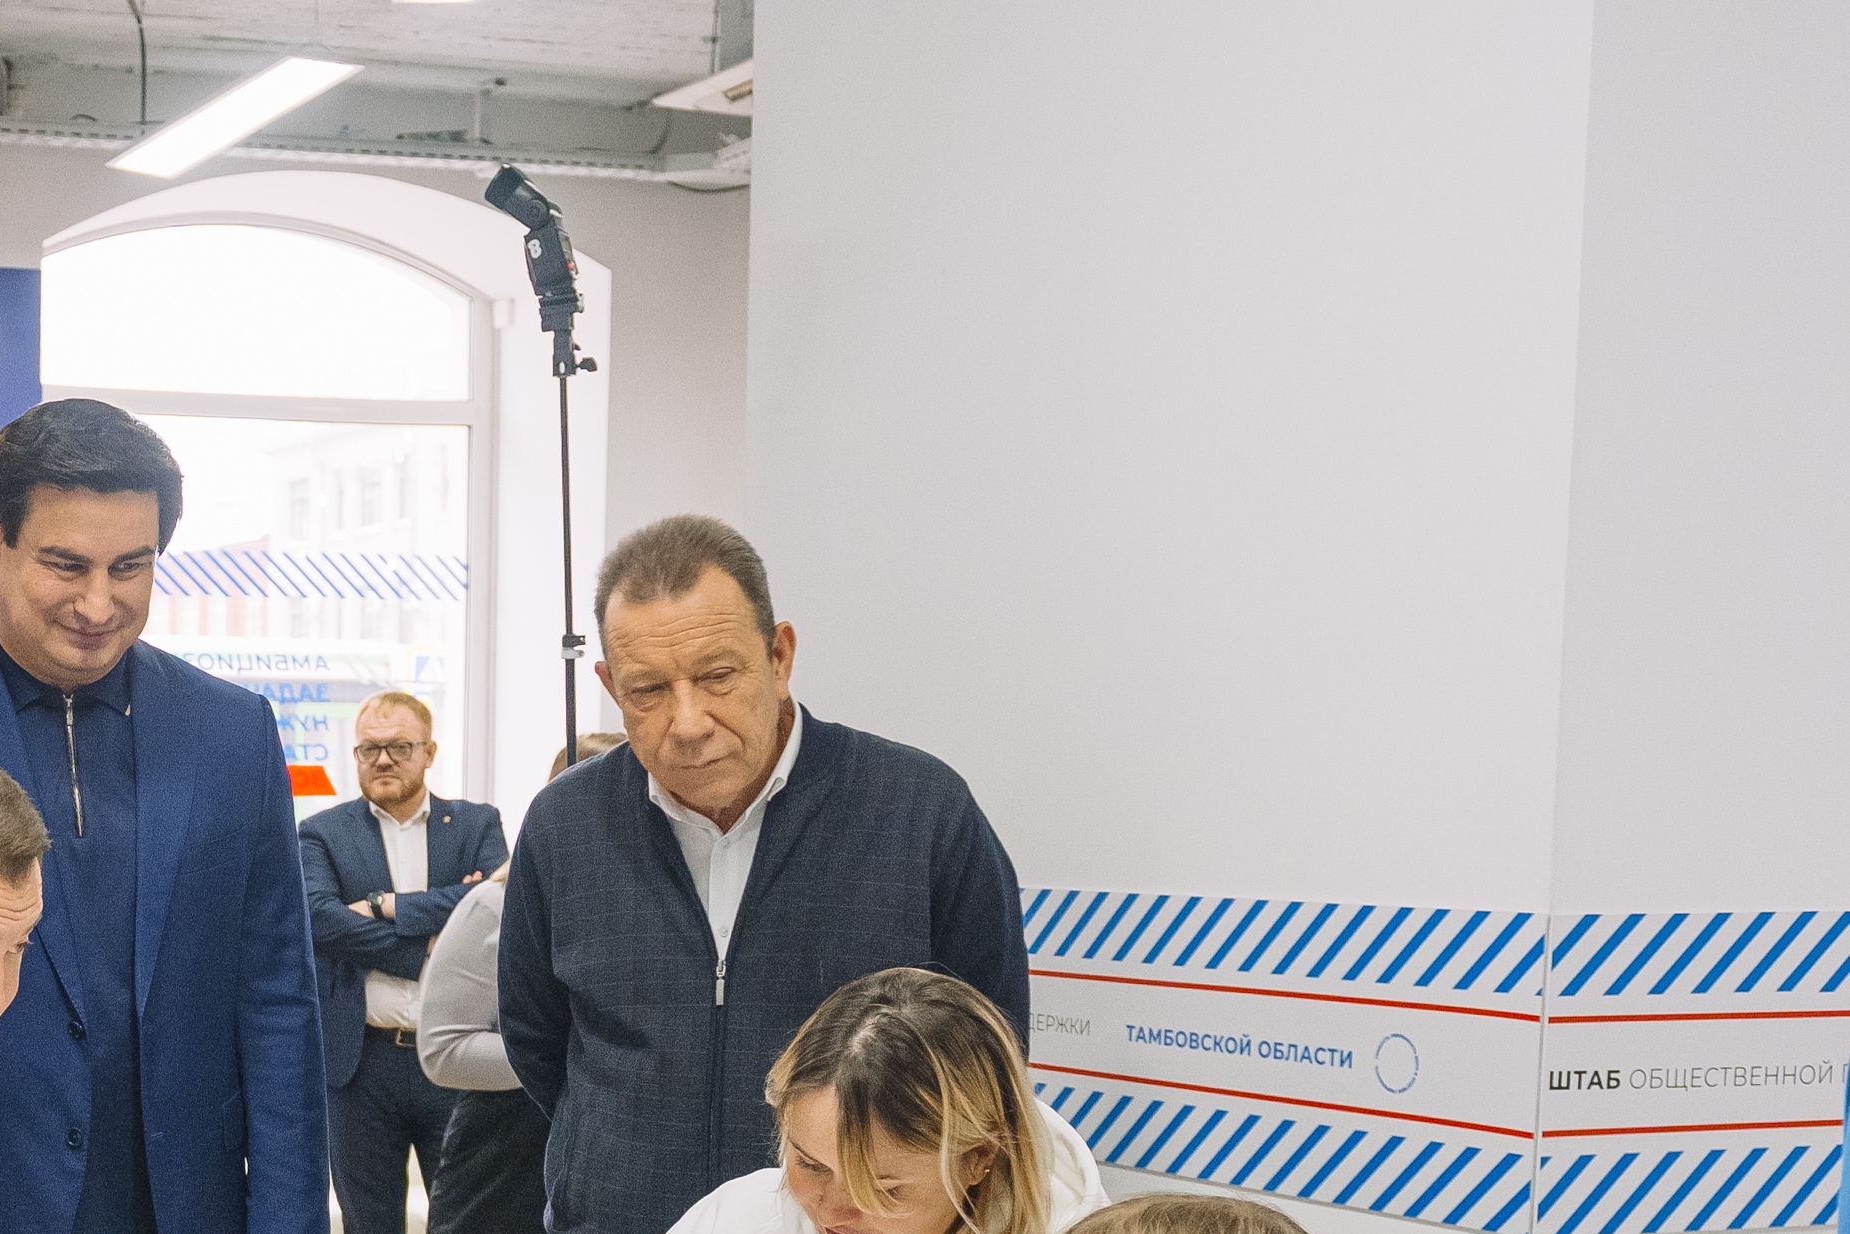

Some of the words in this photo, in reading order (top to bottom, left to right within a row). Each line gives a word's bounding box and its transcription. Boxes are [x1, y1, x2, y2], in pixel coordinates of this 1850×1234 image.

[1030, 1012, 1091, 1036] ДЕРЖКИ
[1126, 1024, 1251, 1057] ТАМБОВСКОЙ
[1258, 1041, 1354, 1069] ОБЛАСТИ
[1549, 1070, 1621, 1090] ШТАБ
[1629, 1060, 1834, 1092] ОБЩЕСТВЕННОЙ
